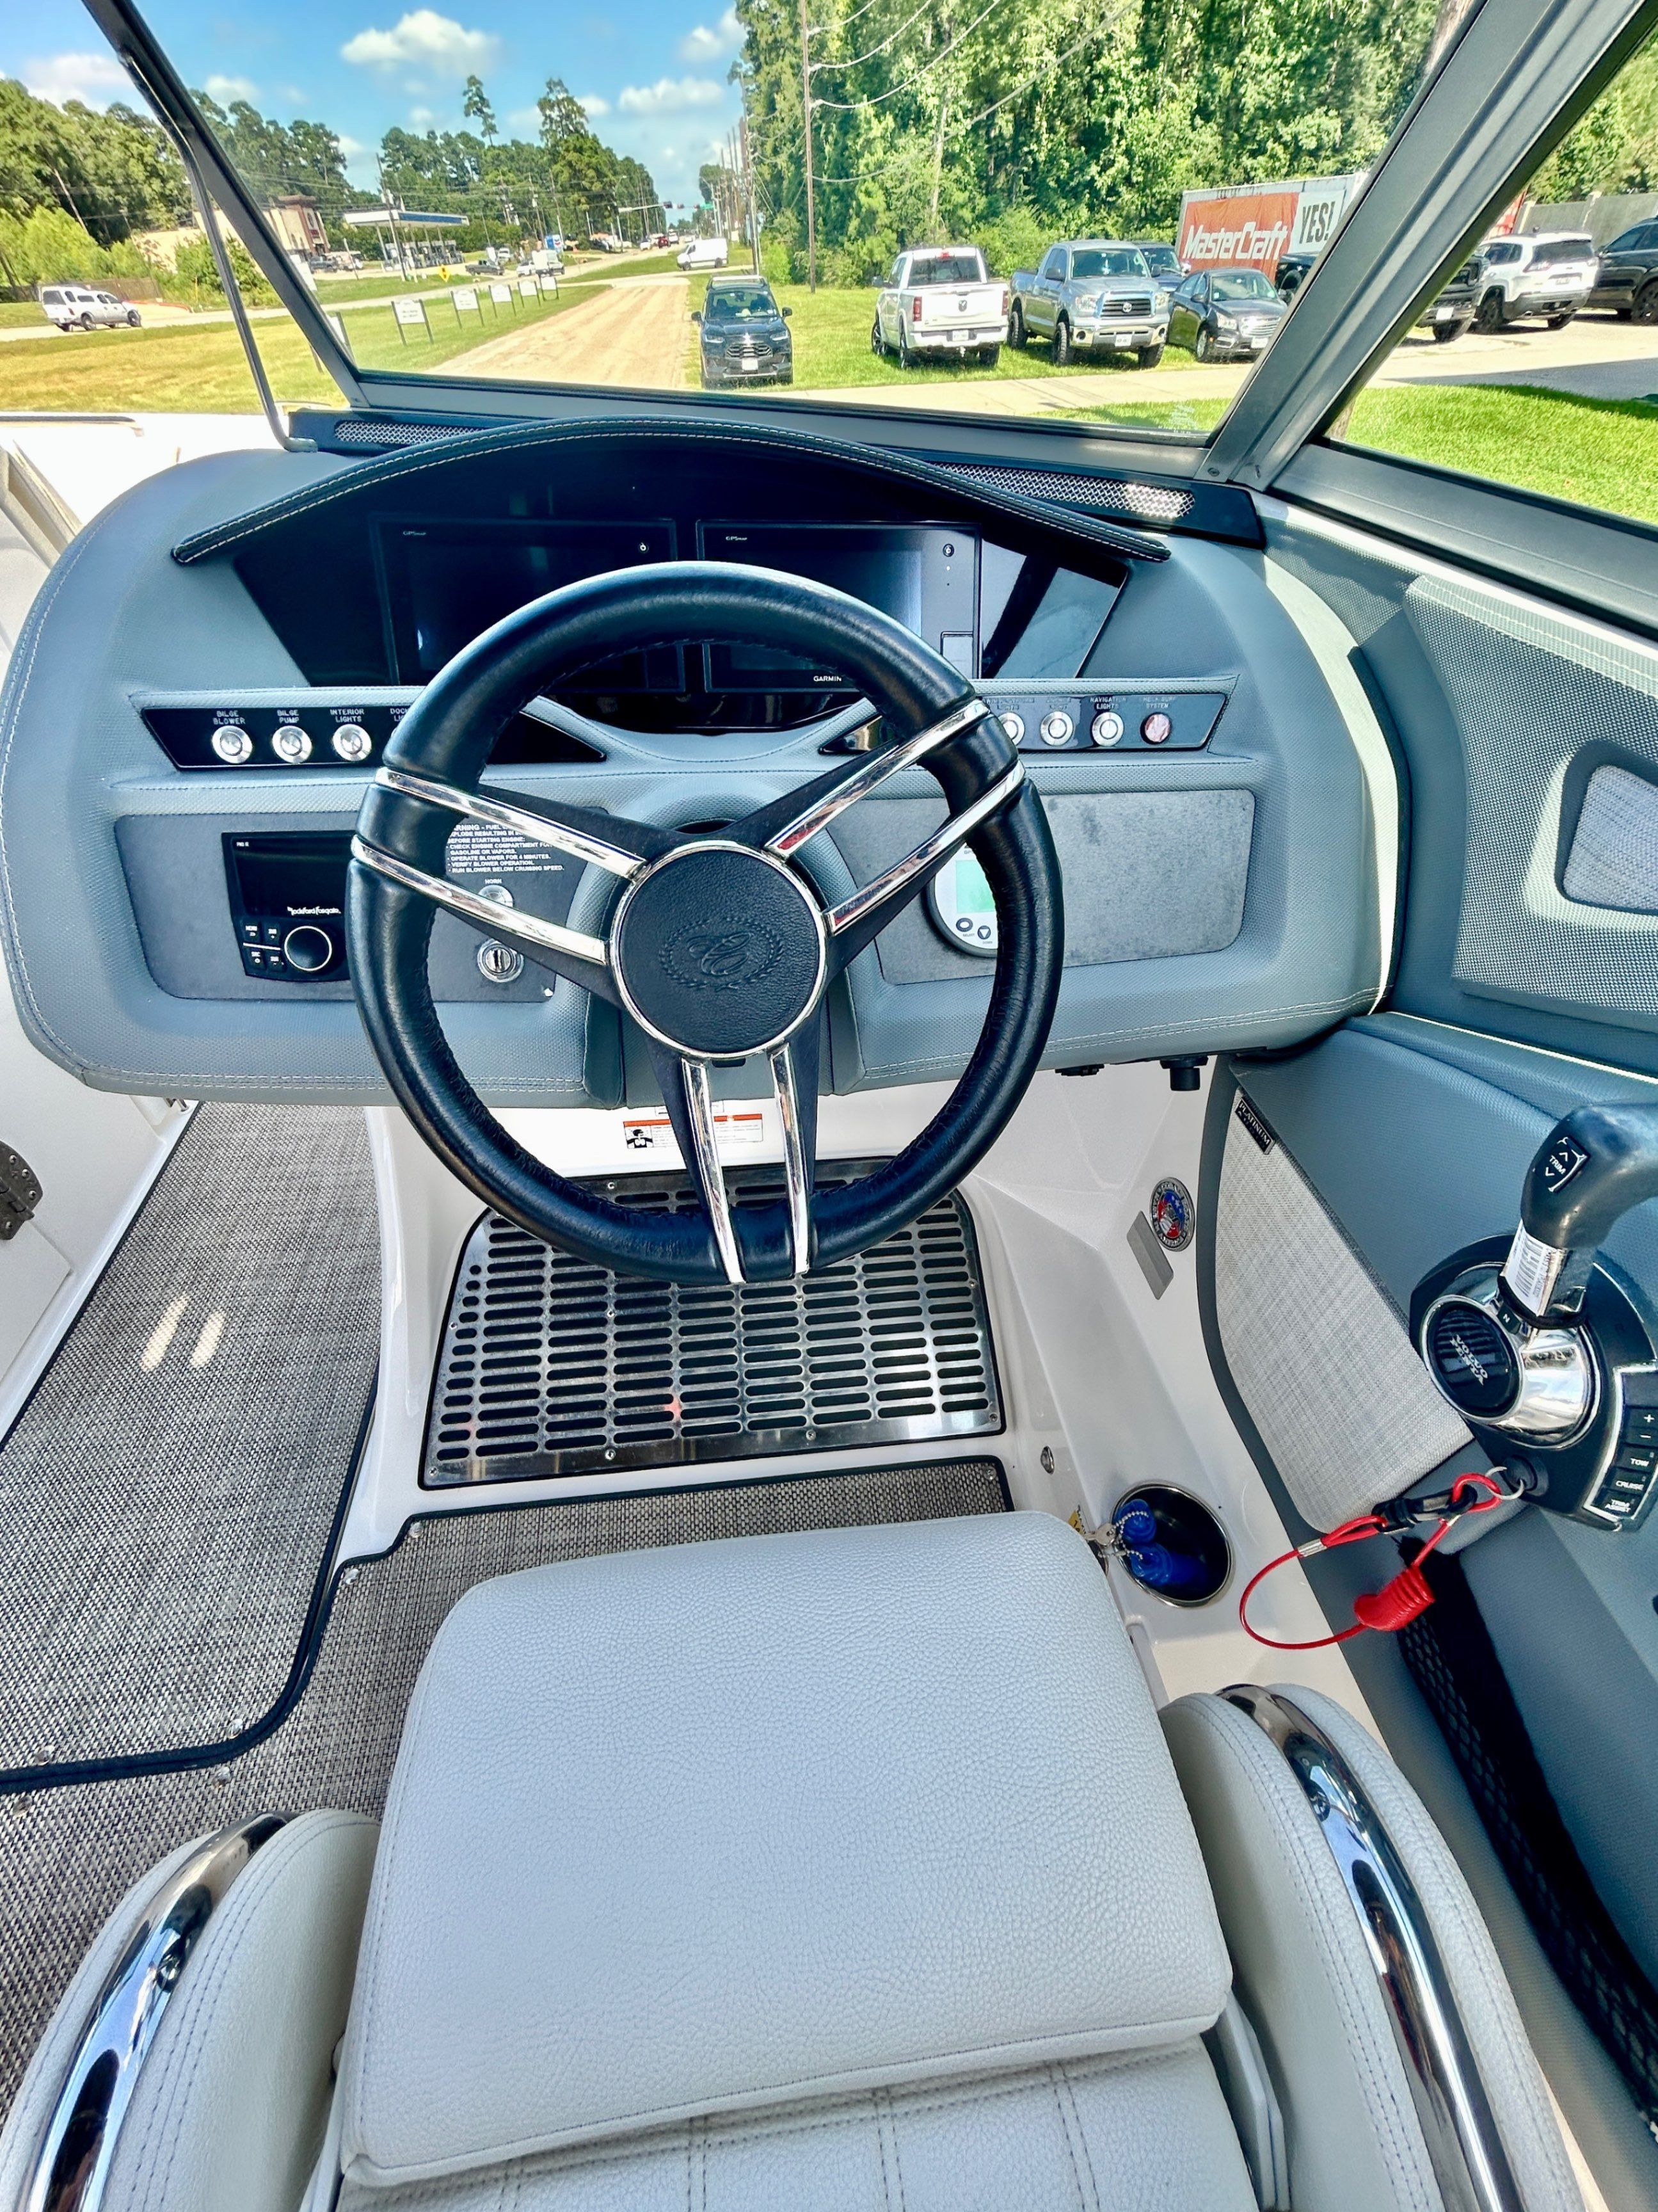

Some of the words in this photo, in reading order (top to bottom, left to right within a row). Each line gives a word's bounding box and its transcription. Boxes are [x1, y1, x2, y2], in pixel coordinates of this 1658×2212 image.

[1183, 220, 1290, 260] MasterCraft
[1299, 200, 1335, 244] YES!
[1239, 1102, 1270, 1144] PLATINUM
[1549, 1155, 1566, 1174] TRIM
[1503, 1314, 1510, 1323] N
[1449, 1336, 1484, 1386] PENTA
[1456, 1334, 1488, 1379] VOLVO
[1630, 1457, 1649, 1466] TOW
[1615, 1480, 1644, 1491] CRUISE
